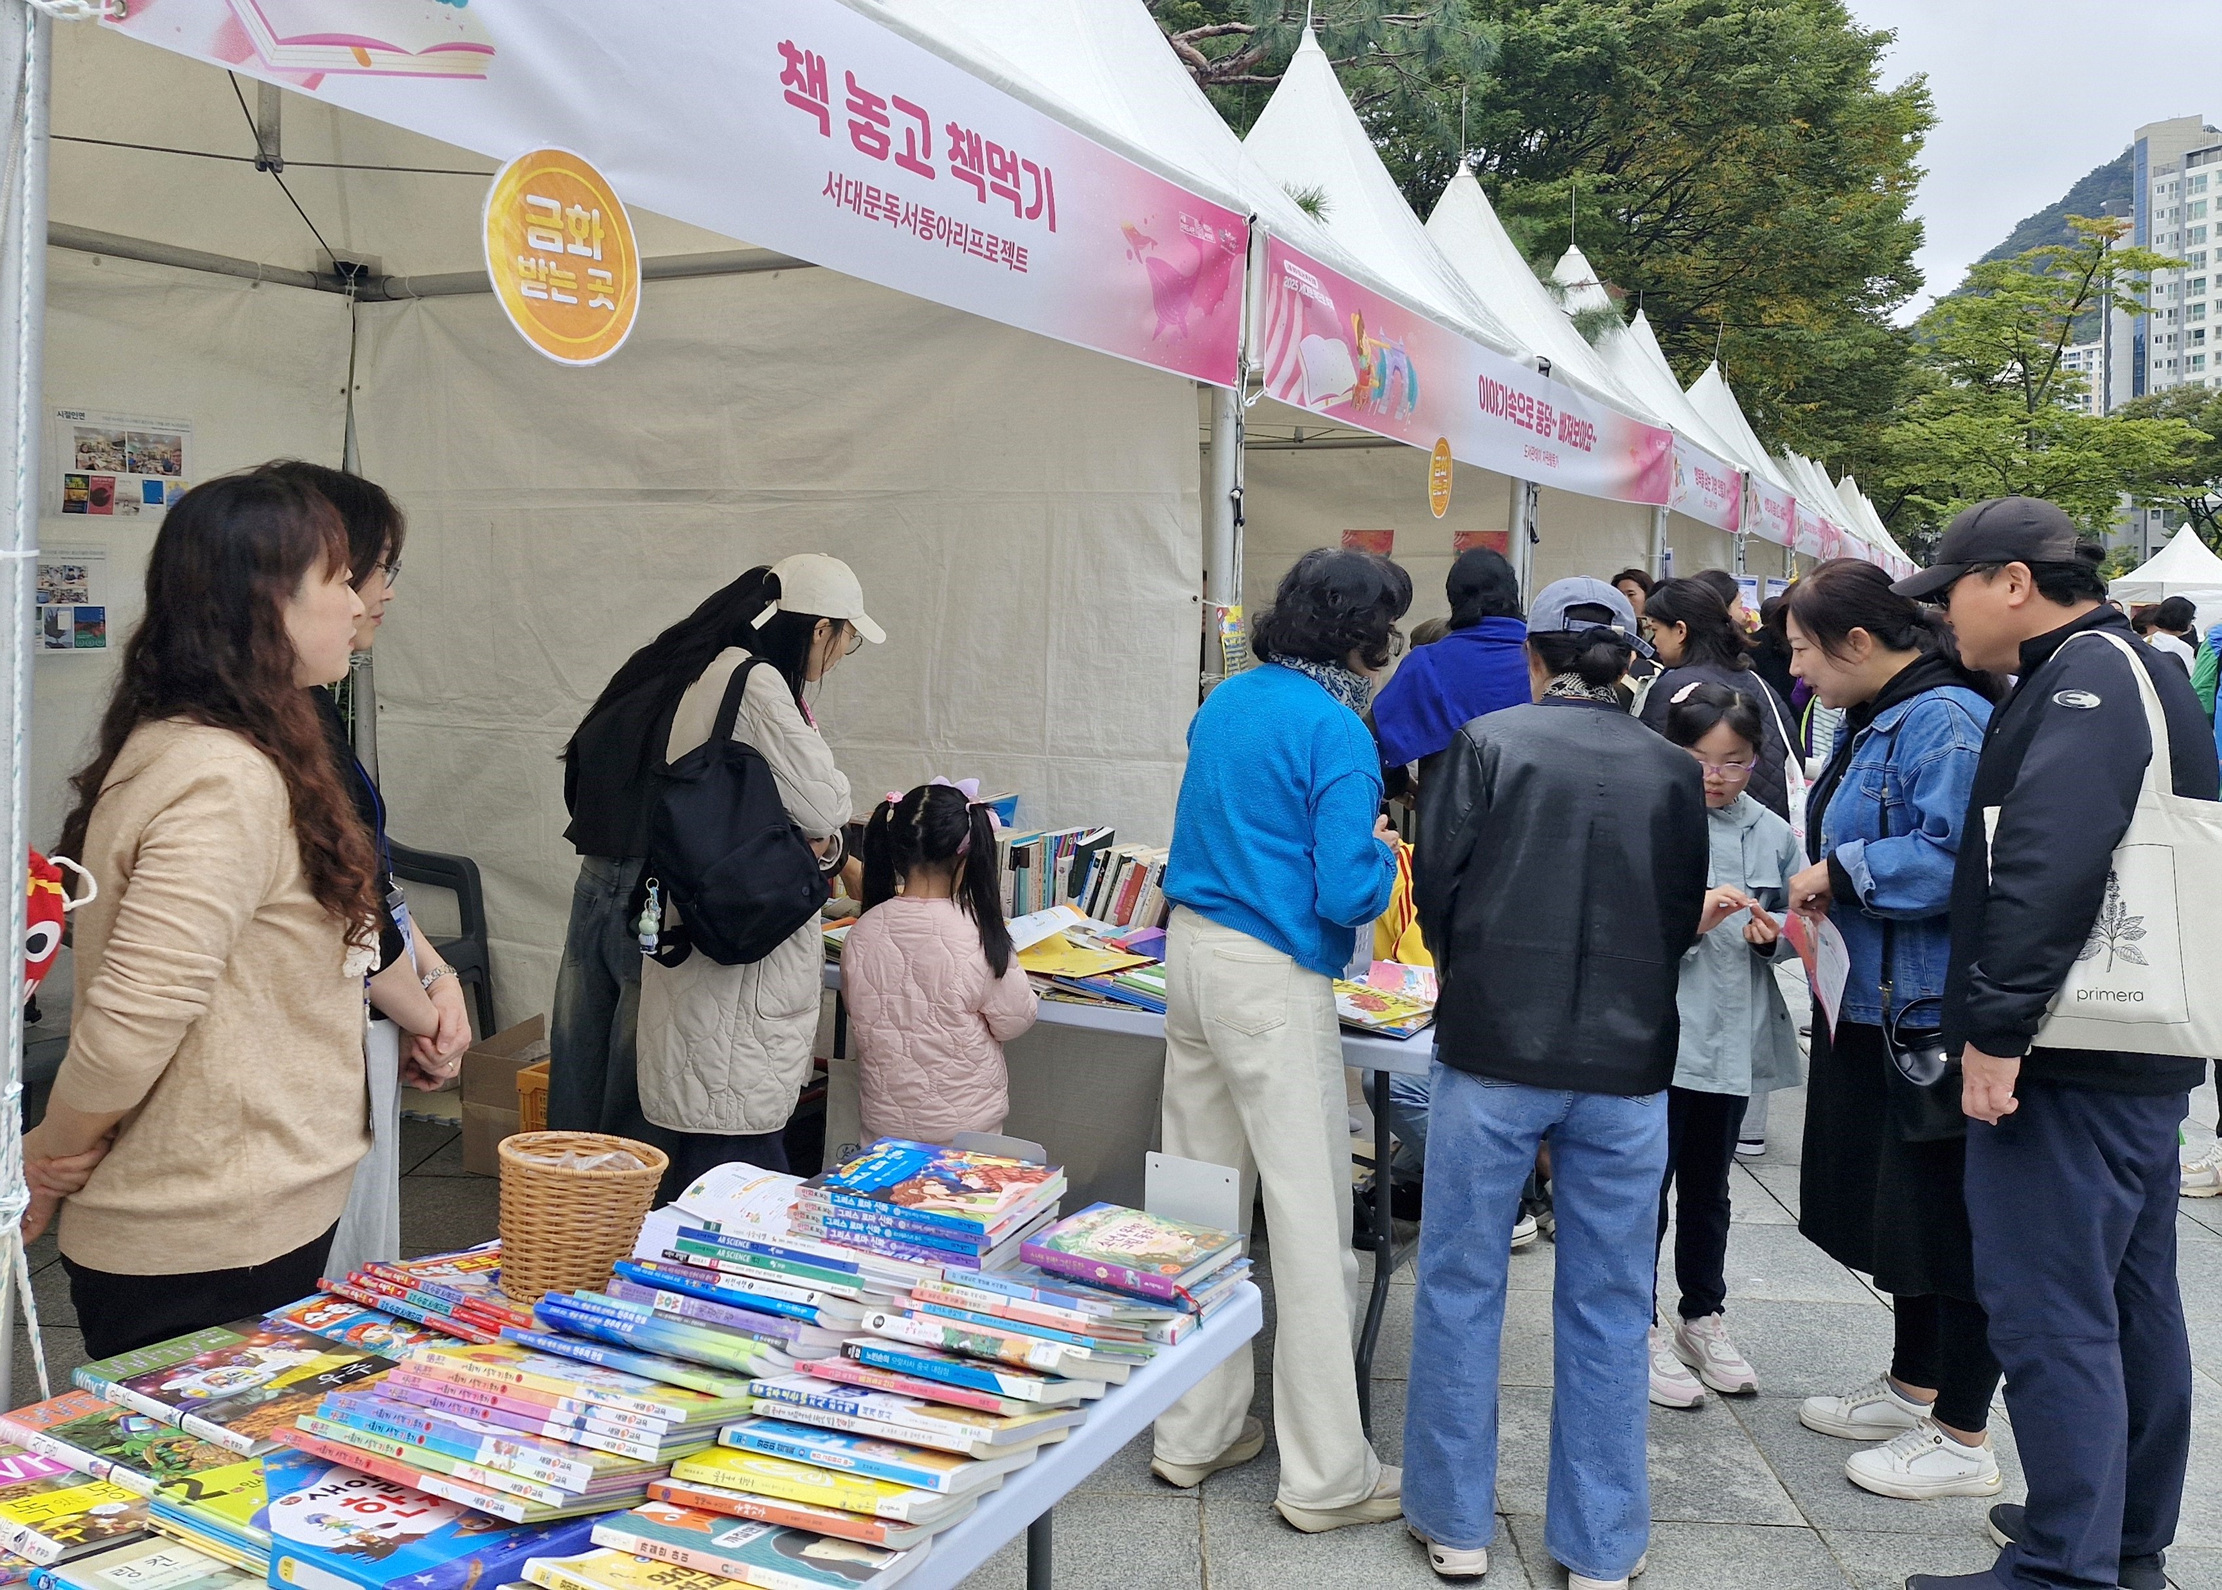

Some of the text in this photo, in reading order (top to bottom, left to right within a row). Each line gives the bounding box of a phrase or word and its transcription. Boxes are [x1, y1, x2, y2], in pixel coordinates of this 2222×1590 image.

[777, 39, 1056, 233] 책 놓고 책먹기
[525, 194, 605, 261] 금화
[821, 171, 1028, 273] 서대문독서동아리프로젝트
[517, 255, 615, 311] 받는 곳
[1479, 374, 1534, 430] 이야기속으로
[2076, 987, 2144, 1003] primera
[833, 1194, 855, 1206] 그리스
[857, 1199, 872, 1209] 로마
[825, 1217, 848, 1228] 그리스
[849, 1221, 865, 1231] 로마
[837, 1208, 860, 1219] 그리스
[861, 1213, 876, 1222] 로마
[717, 1236, 727, 1246] AR
[726, 1237, 750, 1250] SCIENCE
[829, 1229, 852, 1240] 그리스
[854, 1233, 869, 1243] 로마
[716, 1249, 727, 1258] AR
[726, 1250, 751, 1262] SCIENCE
[865, 1351, 890, 1364] 노빈손의
[916, 1361, 930, 1372] 중국
[317, 1362, 373, 1386] 우주
[109, 1387, 134, 1405] 우주
[639, 1542, 690, 1563] 까칠한 아이
